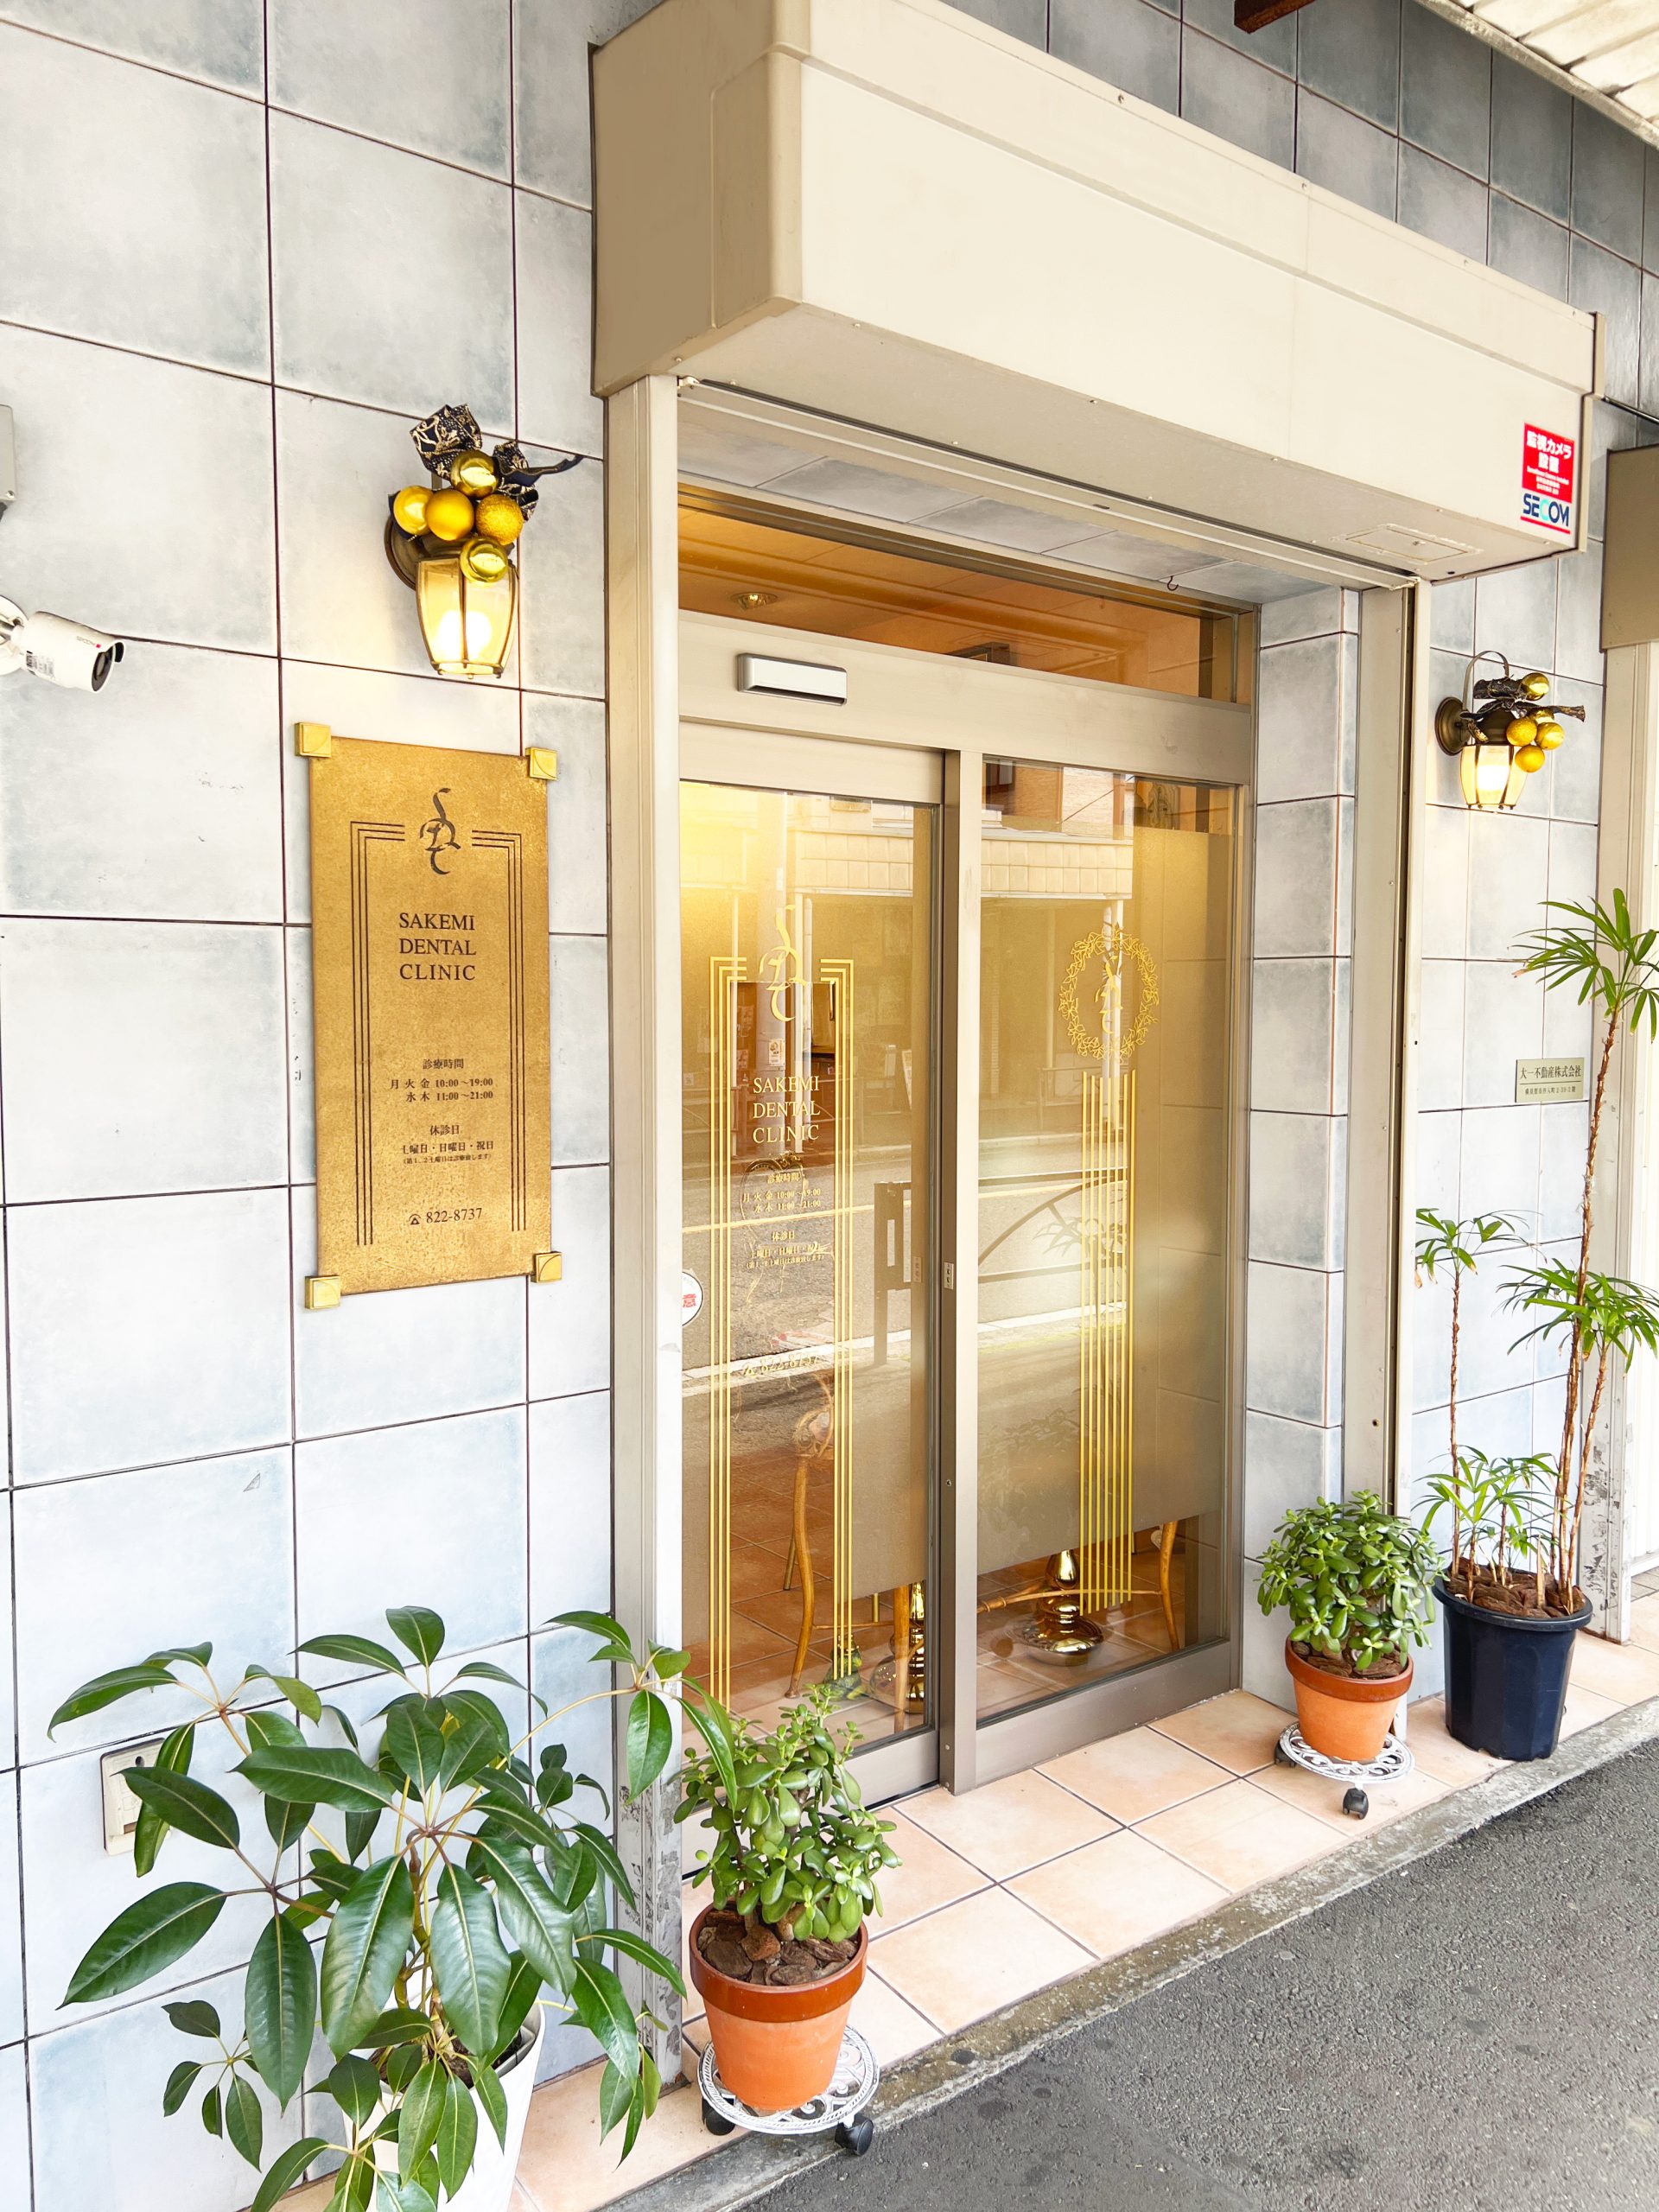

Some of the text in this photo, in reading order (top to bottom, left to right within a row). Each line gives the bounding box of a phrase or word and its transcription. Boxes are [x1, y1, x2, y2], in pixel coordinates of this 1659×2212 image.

[1522, 493, 1570, 527] SECOM
[398, 912, 475, 931] SAKEMI
[398, 938, 477, 956] DENTAL
[399, 964, 476, 981] CLINIC
[423, 1058, 465, 1071] 診療時間
[752, 1075, 820, 1095] SAKEMI
[752, 1100, 821, 1120] DENTAL
[429, 1125, 461, 1136] 休診日
[752, 1124, 820, 1144] CLINIC
[767, 1173, 800, 1184] 診療時間
[426, 1208, 482, 1224] 822-8737
